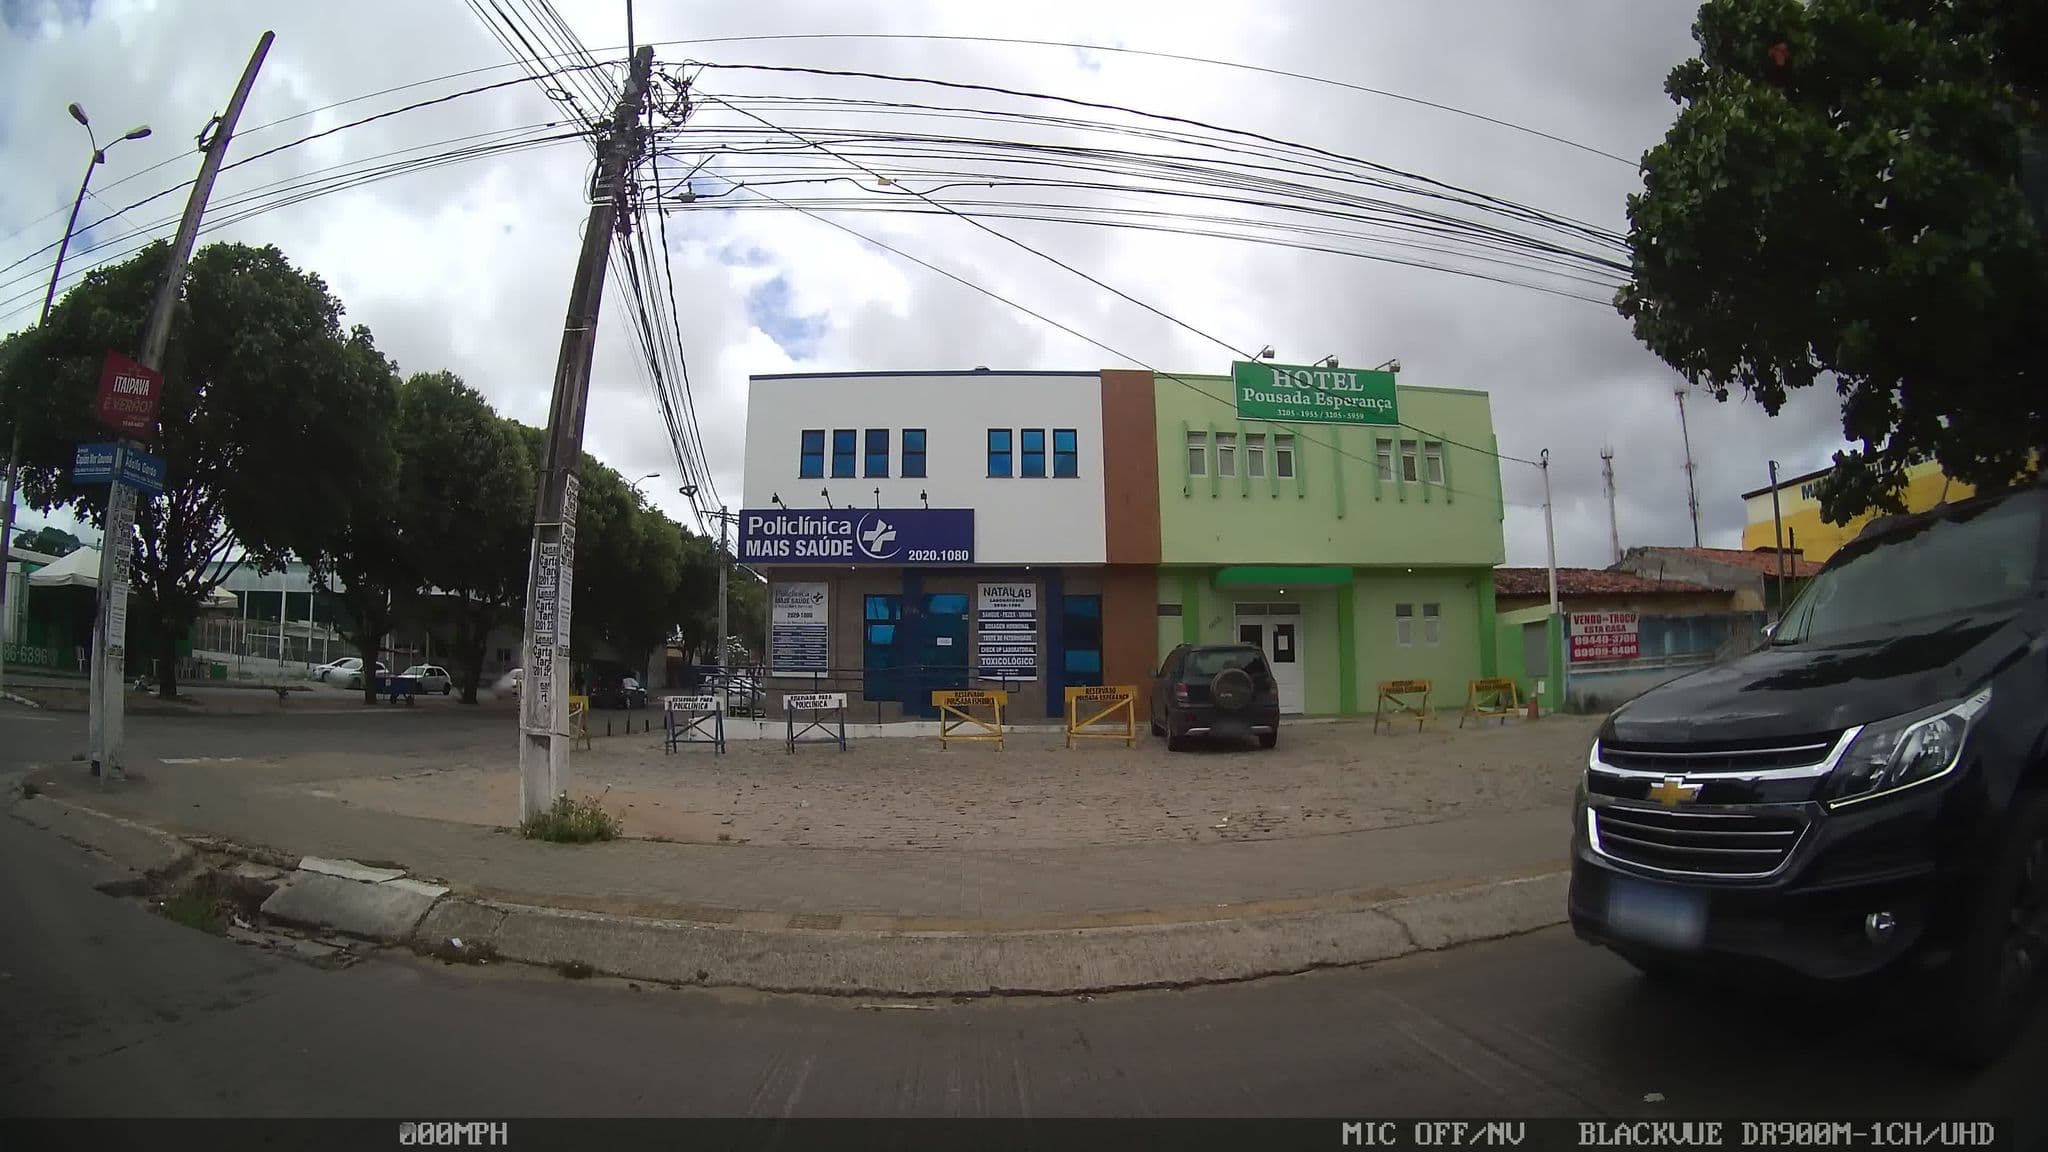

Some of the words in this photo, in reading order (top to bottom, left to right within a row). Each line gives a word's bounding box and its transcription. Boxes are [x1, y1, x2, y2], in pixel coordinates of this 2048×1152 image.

[113, 376, 150, 396] ITAIPAVA
[1271, 368, 1364, 392] HOTEL
[1242, 387, 1311, 405] Pousada
[1315, 392, 1392, 412] Esperança
[748, 516, 852, 536] Policlínica
[746, 539, 790, 557] MAIS
[795, 536, 853, 556] SAÚDE
[908, 550, 969, 561] 2020.1080
[1574, 614, 1602, 625] VENDO
